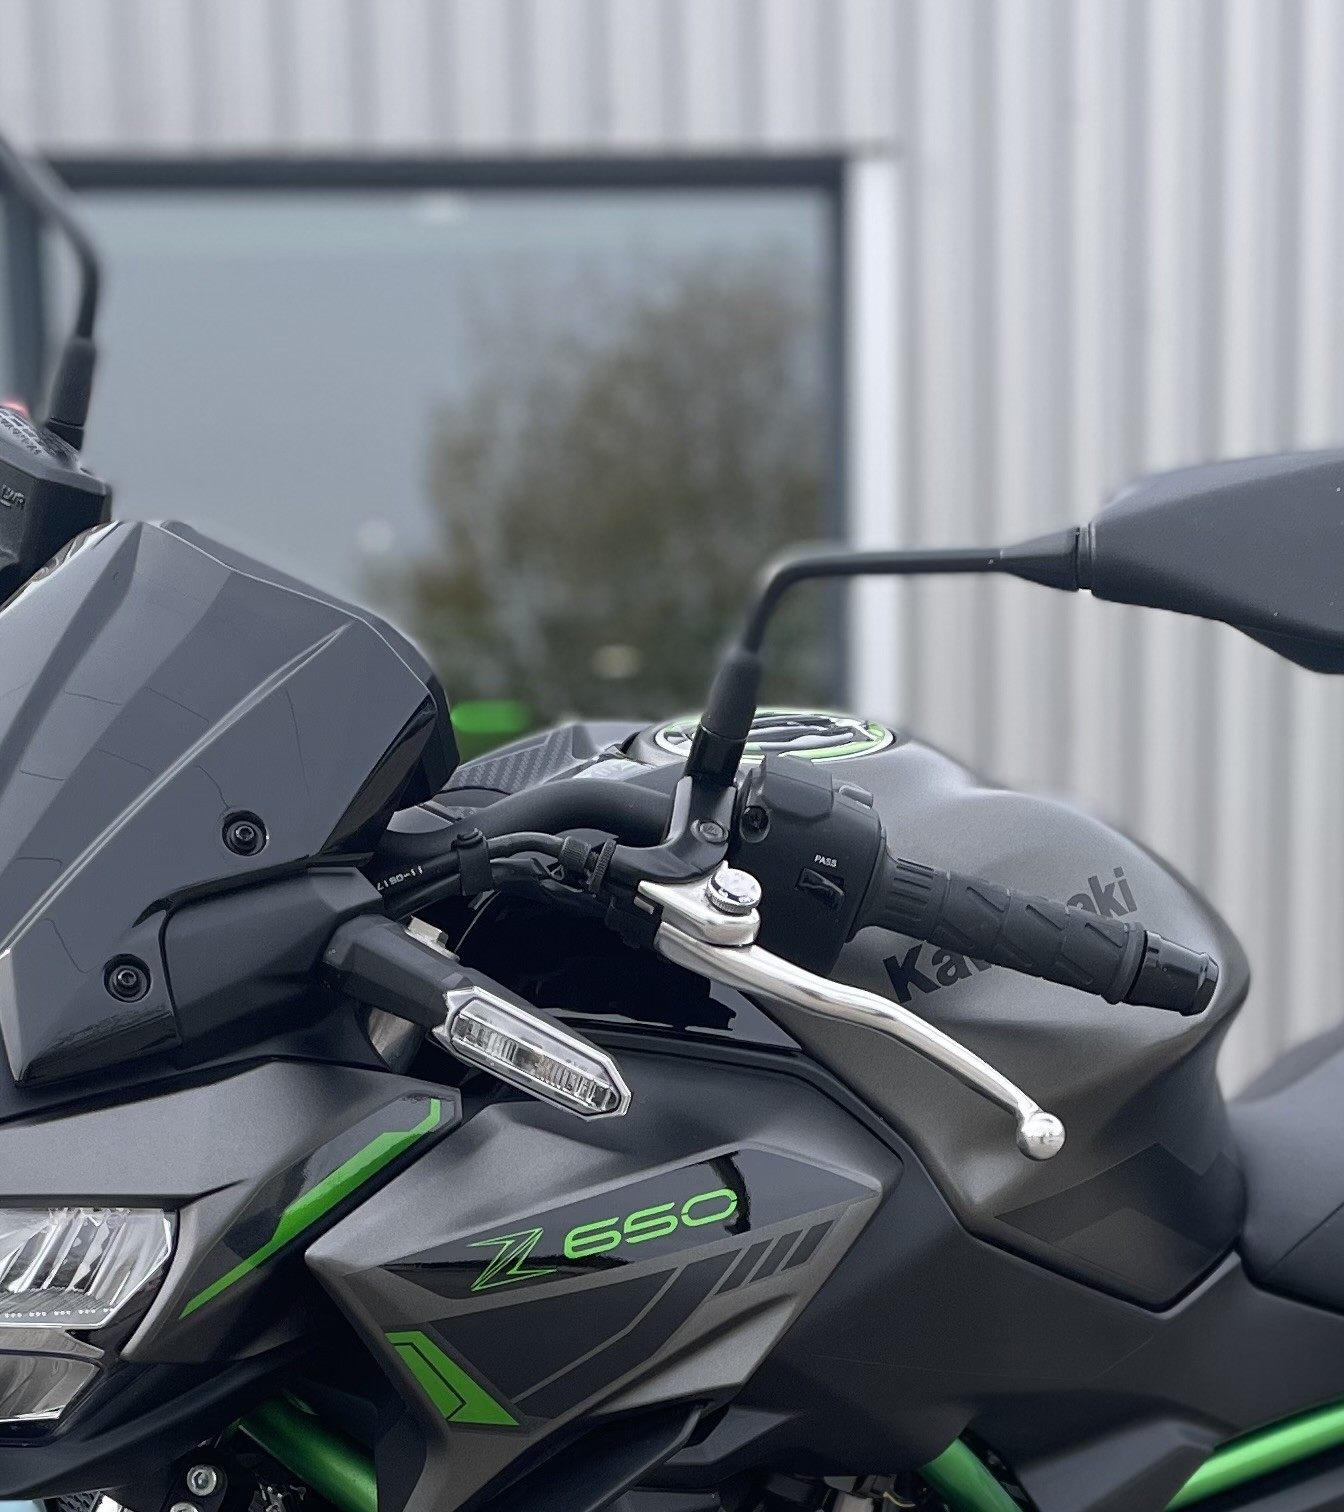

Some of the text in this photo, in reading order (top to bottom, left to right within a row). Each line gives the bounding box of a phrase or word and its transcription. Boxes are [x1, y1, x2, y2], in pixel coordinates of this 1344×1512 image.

[814, 854, 838, 868] PASS
[883, 866, 1138, 1003] Kaaki
[466, 1187, 739, 1291] Z 650
